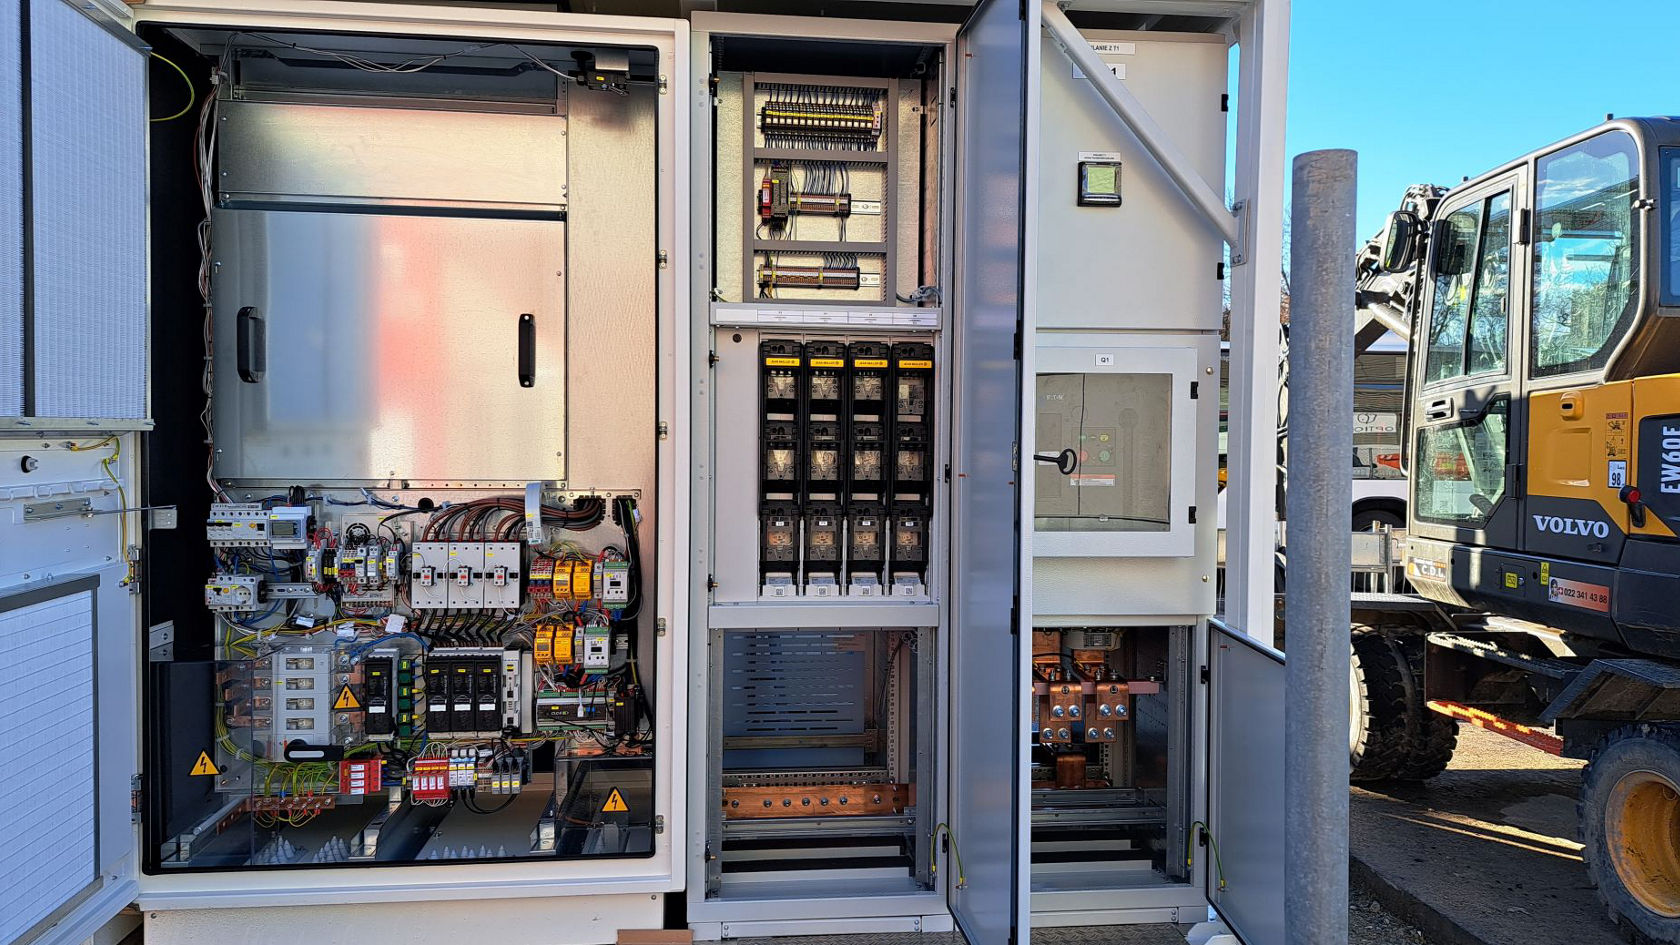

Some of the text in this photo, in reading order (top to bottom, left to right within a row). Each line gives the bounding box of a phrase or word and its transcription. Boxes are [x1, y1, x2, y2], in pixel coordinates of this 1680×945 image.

[1612, 472, 1621, 485] 98
[1533, 515, 1609, 538] VOLVO
[1421, 564, 1446, 579] C.D.L.
[1564, 588, 1576, 598] 022
[1576, 590, 1588, 600] 341
[1589, 592, 1598, 602] 43
